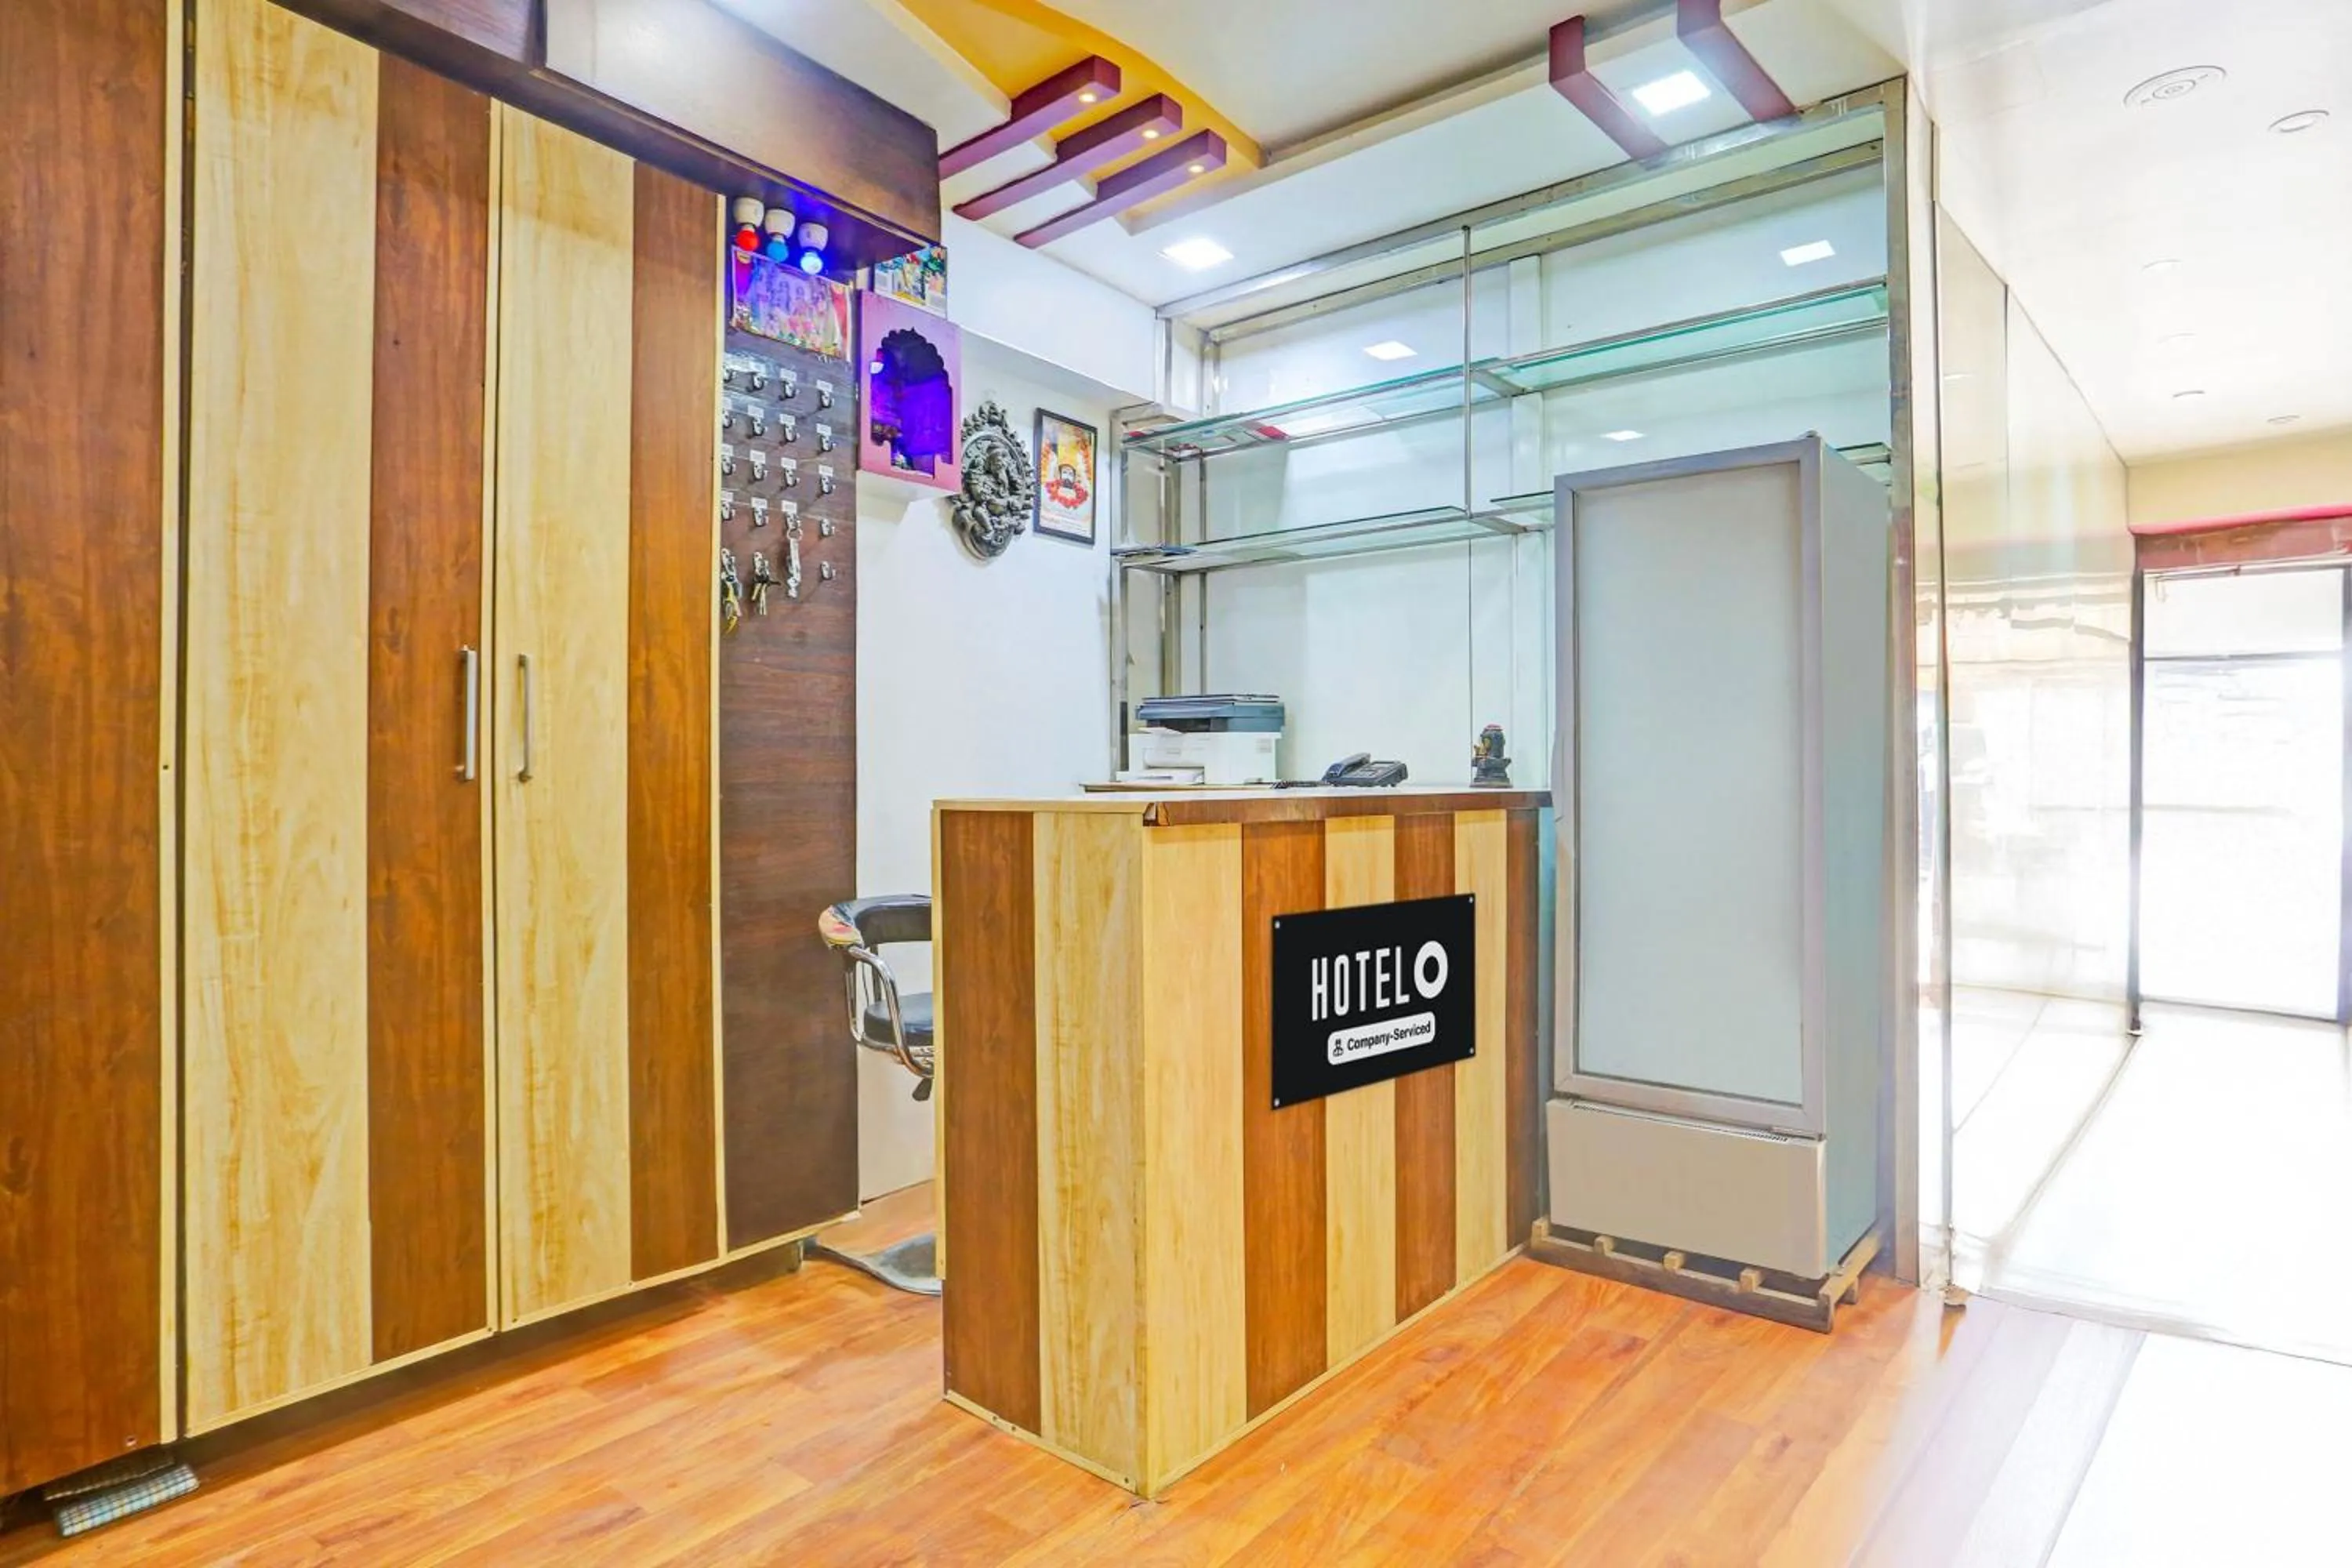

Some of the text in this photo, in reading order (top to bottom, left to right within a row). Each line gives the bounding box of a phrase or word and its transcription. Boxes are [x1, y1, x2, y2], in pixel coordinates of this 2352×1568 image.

[1312, 940, 1449, 1021] HOTEL O
[1347, 1021, 1431, 1051] Company-Serviced
